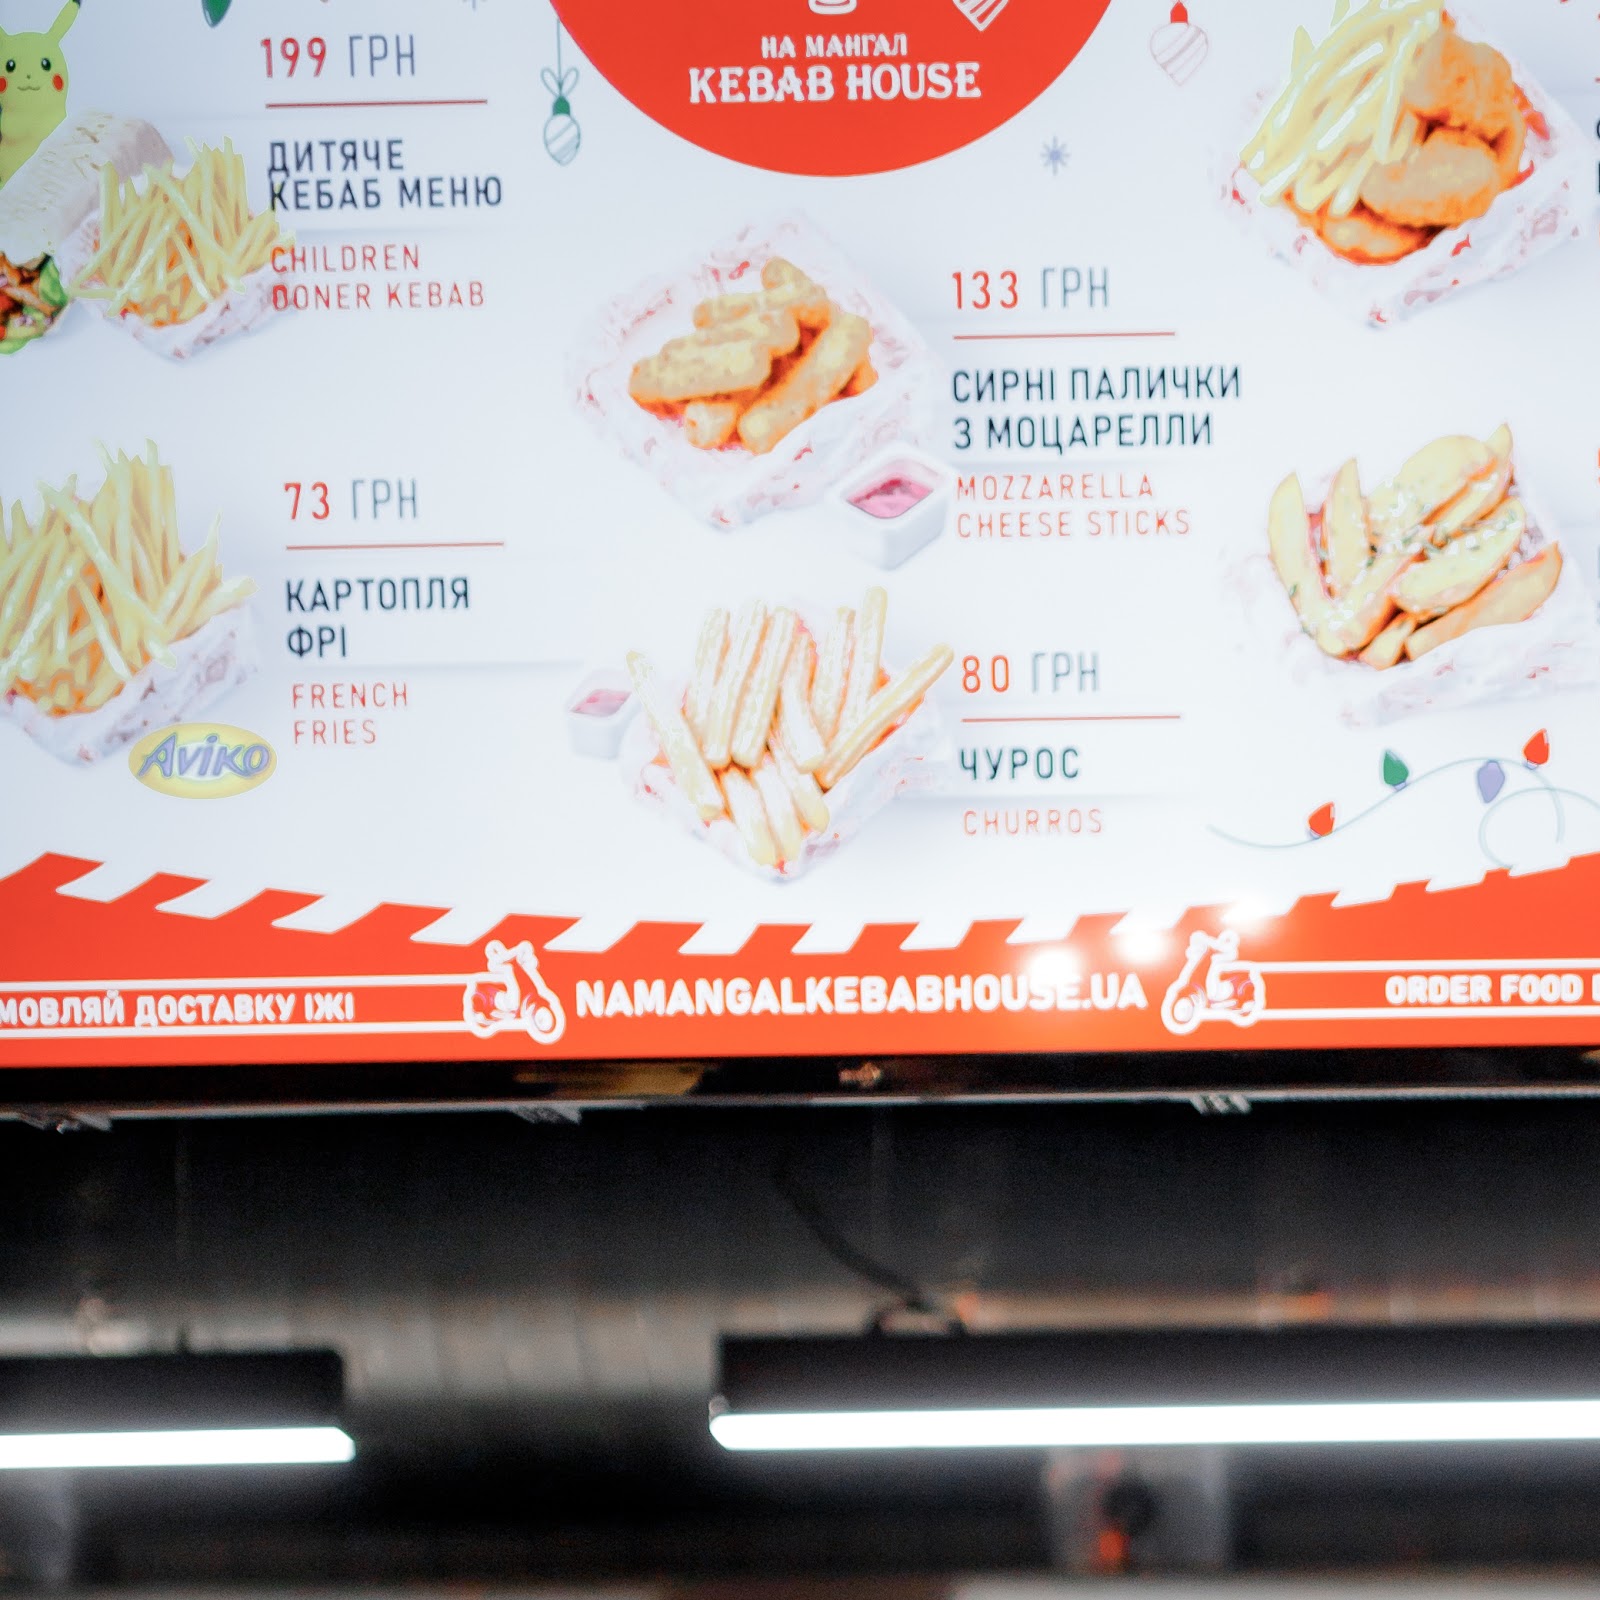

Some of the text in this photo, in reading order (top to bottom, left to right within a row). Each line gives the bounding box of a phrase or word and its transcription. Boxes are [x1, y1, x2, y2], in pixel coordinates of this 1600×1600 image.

[259, 34, 417, 78] 199 ГРН
[760, 33, 907, 58] НА МАНГАЛ
[688, 62, 982, 104] KEBAB HOUSE
[266, 139, 405, 180] ДИТЯЧЕ
[268, 176, 503, 212] КЕБАБ МЕНЮ
[270, 244, 420, 274] CHILDREN
[270, 281, 486, 312] DONER KEBAB
[951, 267, 1110, 310] 133 ГРН
[952, 366, 1241, 403] СИРНІ ПАЛИЧКИ
[987, 414, 1214, 454] МОЦАРЕЛЛИ
[285, 480, 419, 520] 73 ГРН
[957, 473, 1154, 501] MOZZARELLA
[957, 510, 1191, 538] CHEESE STICKS
[286, 576, 470, 613] КАРТОПЛЯ
[287, 625, 350, 659] ФРІ
[961, 651, 1101, 694] 80 ГРН
[291, 681, 410, 709] FRENCH
[293, 718, 378, 746] FRIES
[959, 748, 1080, 780] ЧУРОС
[962, 809, 1103, 836] CHURROS
[576, 973, 1148, 1018] NAMANGALKEBABHOUSE.UA
[1385, 976, 1491, 1004] ORDER
[1501, 974, 1583, 1002] FOOD
[135, 993, 294, 1028] ДОСТАВКУ
